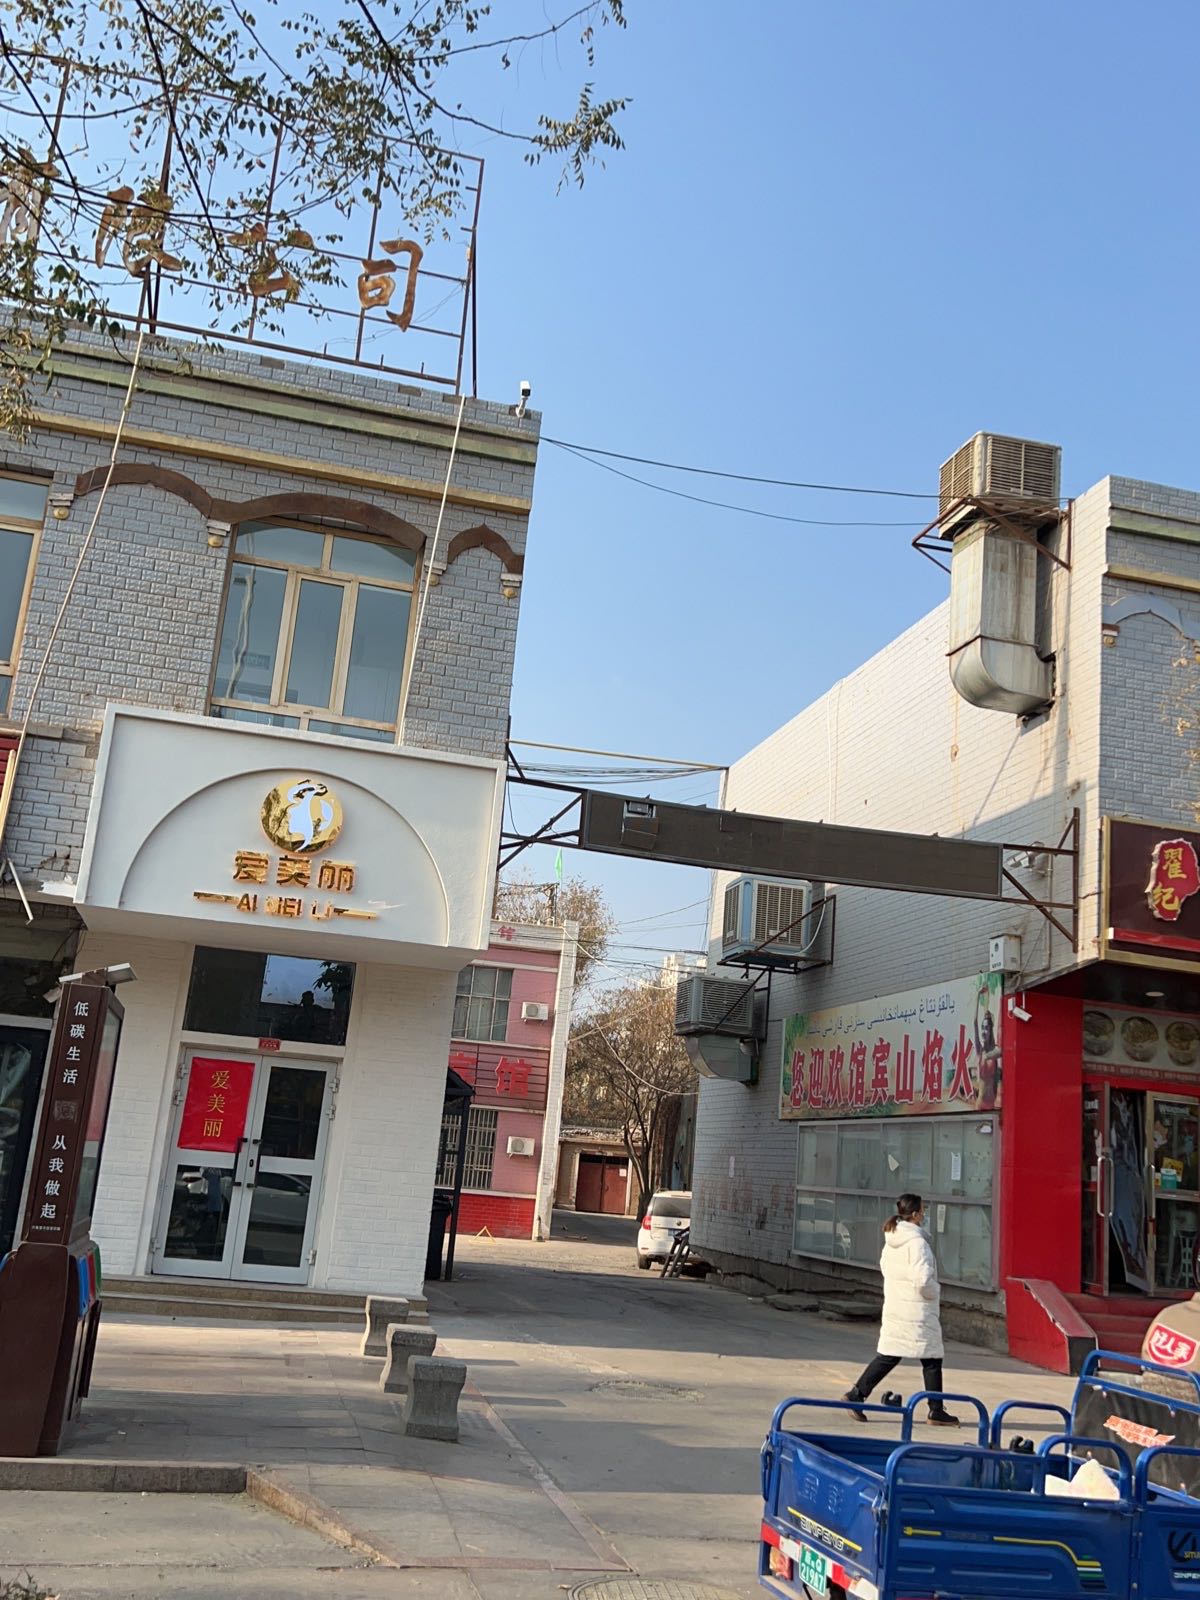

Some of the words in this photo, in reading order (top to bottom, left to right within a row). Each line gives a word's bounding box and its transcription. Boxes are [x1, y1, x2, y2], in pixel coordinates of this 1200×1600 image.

[232, 850, 357, 894] 爱美丽
[62, 1001, 90, 1085] 低碳生活
[203, 1070, 231, 1138] 爱美丽
[39, 1135, 67, 1219] 从我做起
